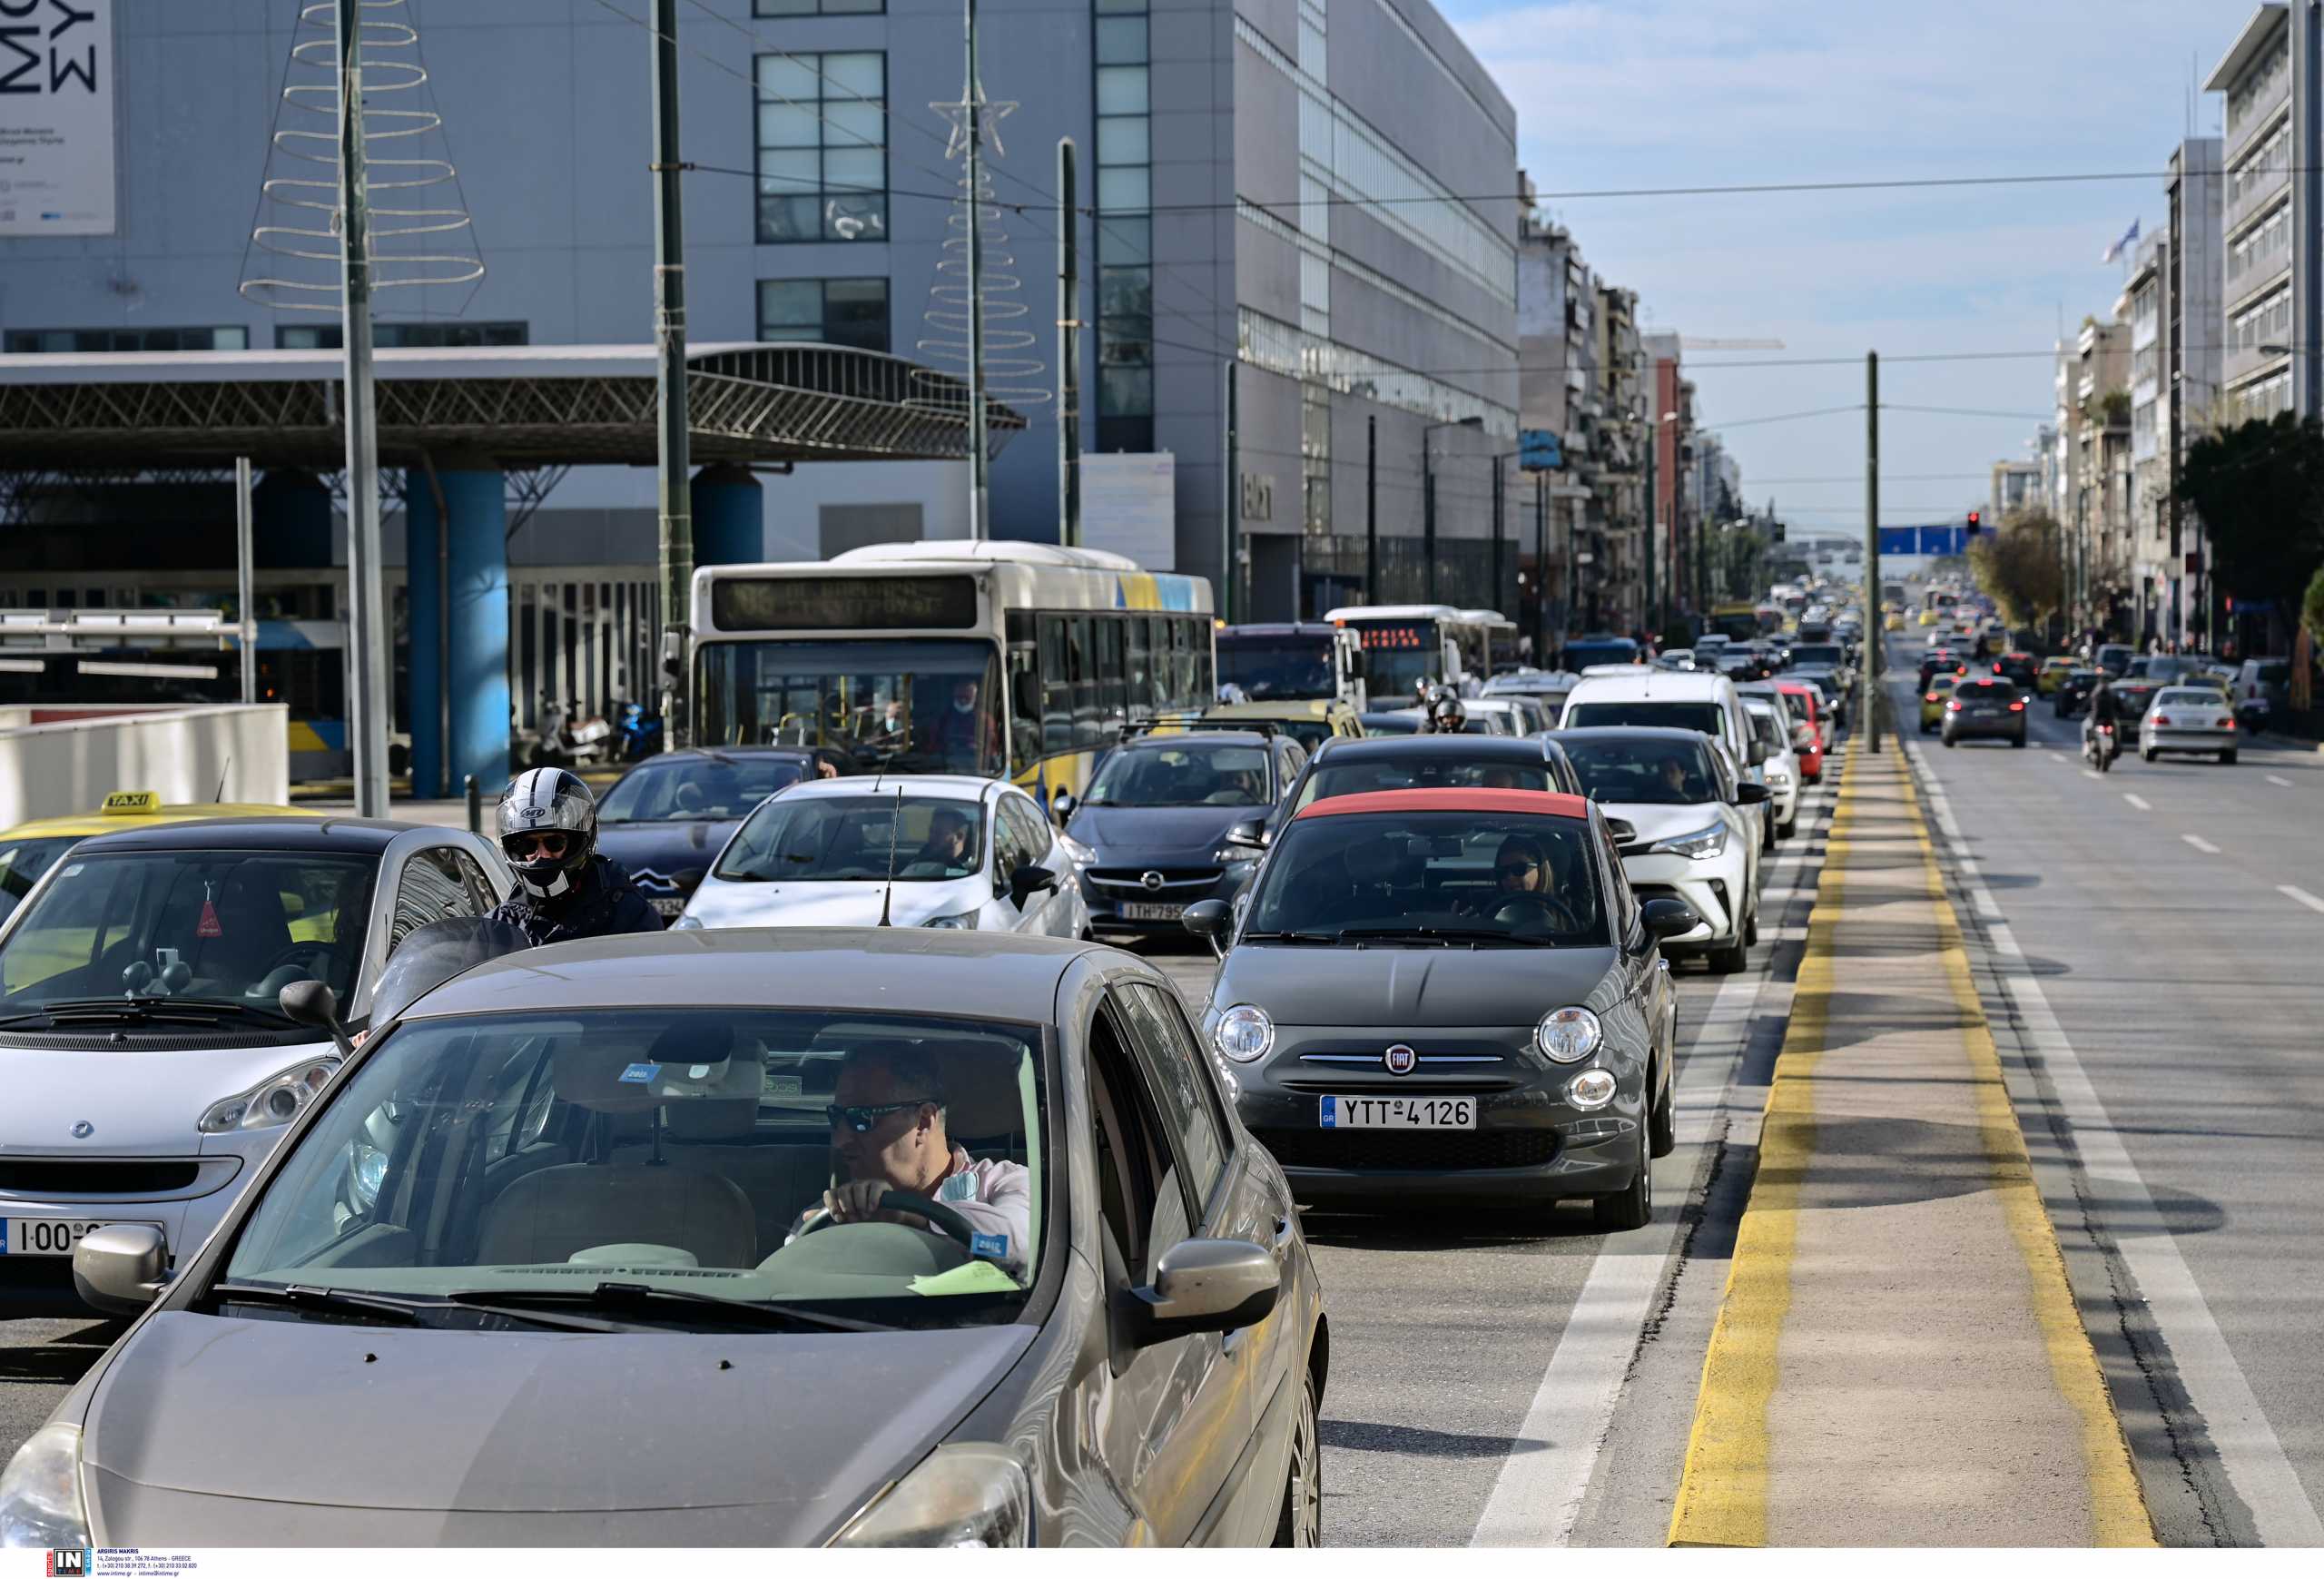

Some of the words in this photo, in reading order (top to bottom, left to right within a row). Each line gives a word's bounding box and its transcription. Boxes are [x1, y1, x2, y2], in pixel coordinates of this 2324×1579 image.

[108, 794, 149, 806] TAXI
[1393, 1053, 1409, 1067] FIAT
[1323, 1114, 1334, 1122] GR
[1344, 1100, 1470, 1125] YTT-4126
